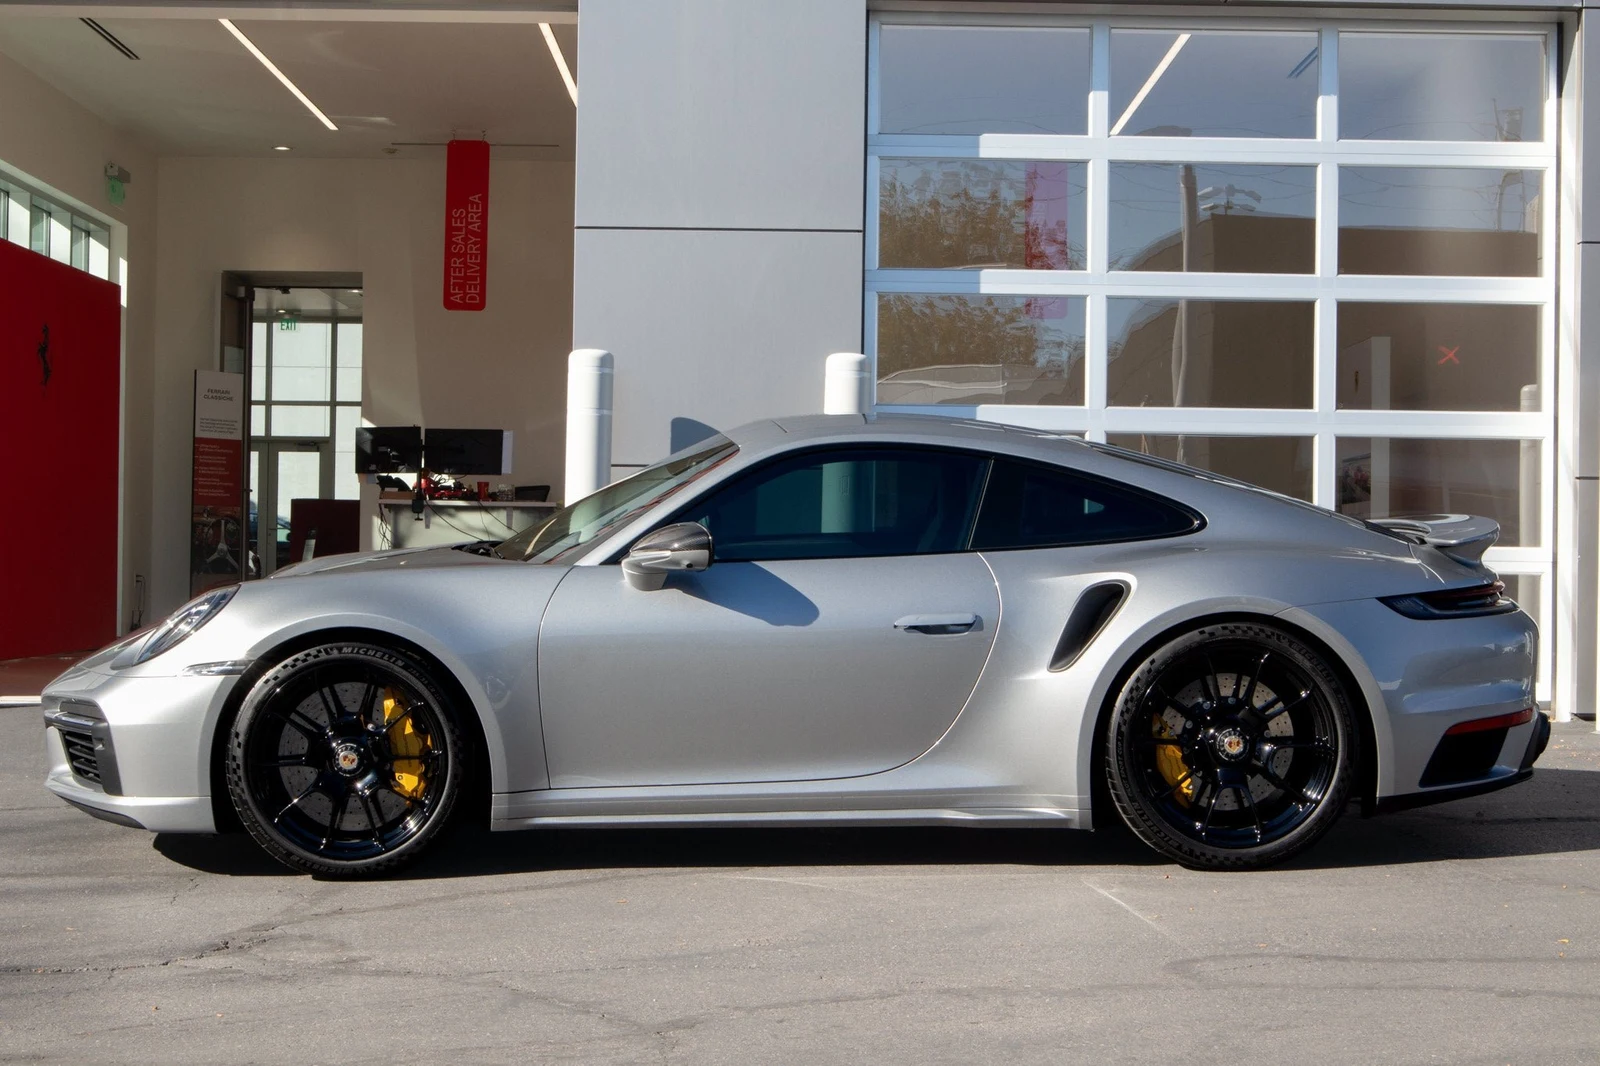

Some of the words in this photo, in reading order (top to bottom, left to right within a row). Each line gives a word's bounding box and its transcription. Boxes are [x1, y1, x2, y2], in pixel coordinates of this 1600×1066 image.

[452, 208, 466, 253] SALES
[469, 193, 482, 232] AREA
[451, 256, 465, 303] AFTER
[466, 234, 481, 304] DELIVERY
[280, 319, 296, 331] EXIT
[341, 646, 406, 668] MICHELIN
[1290, 641, 1338, 690] MICHELIN
[253, 821, 272, 841] SPORT
[1130, 800, 1180, 849] MICHELIN
